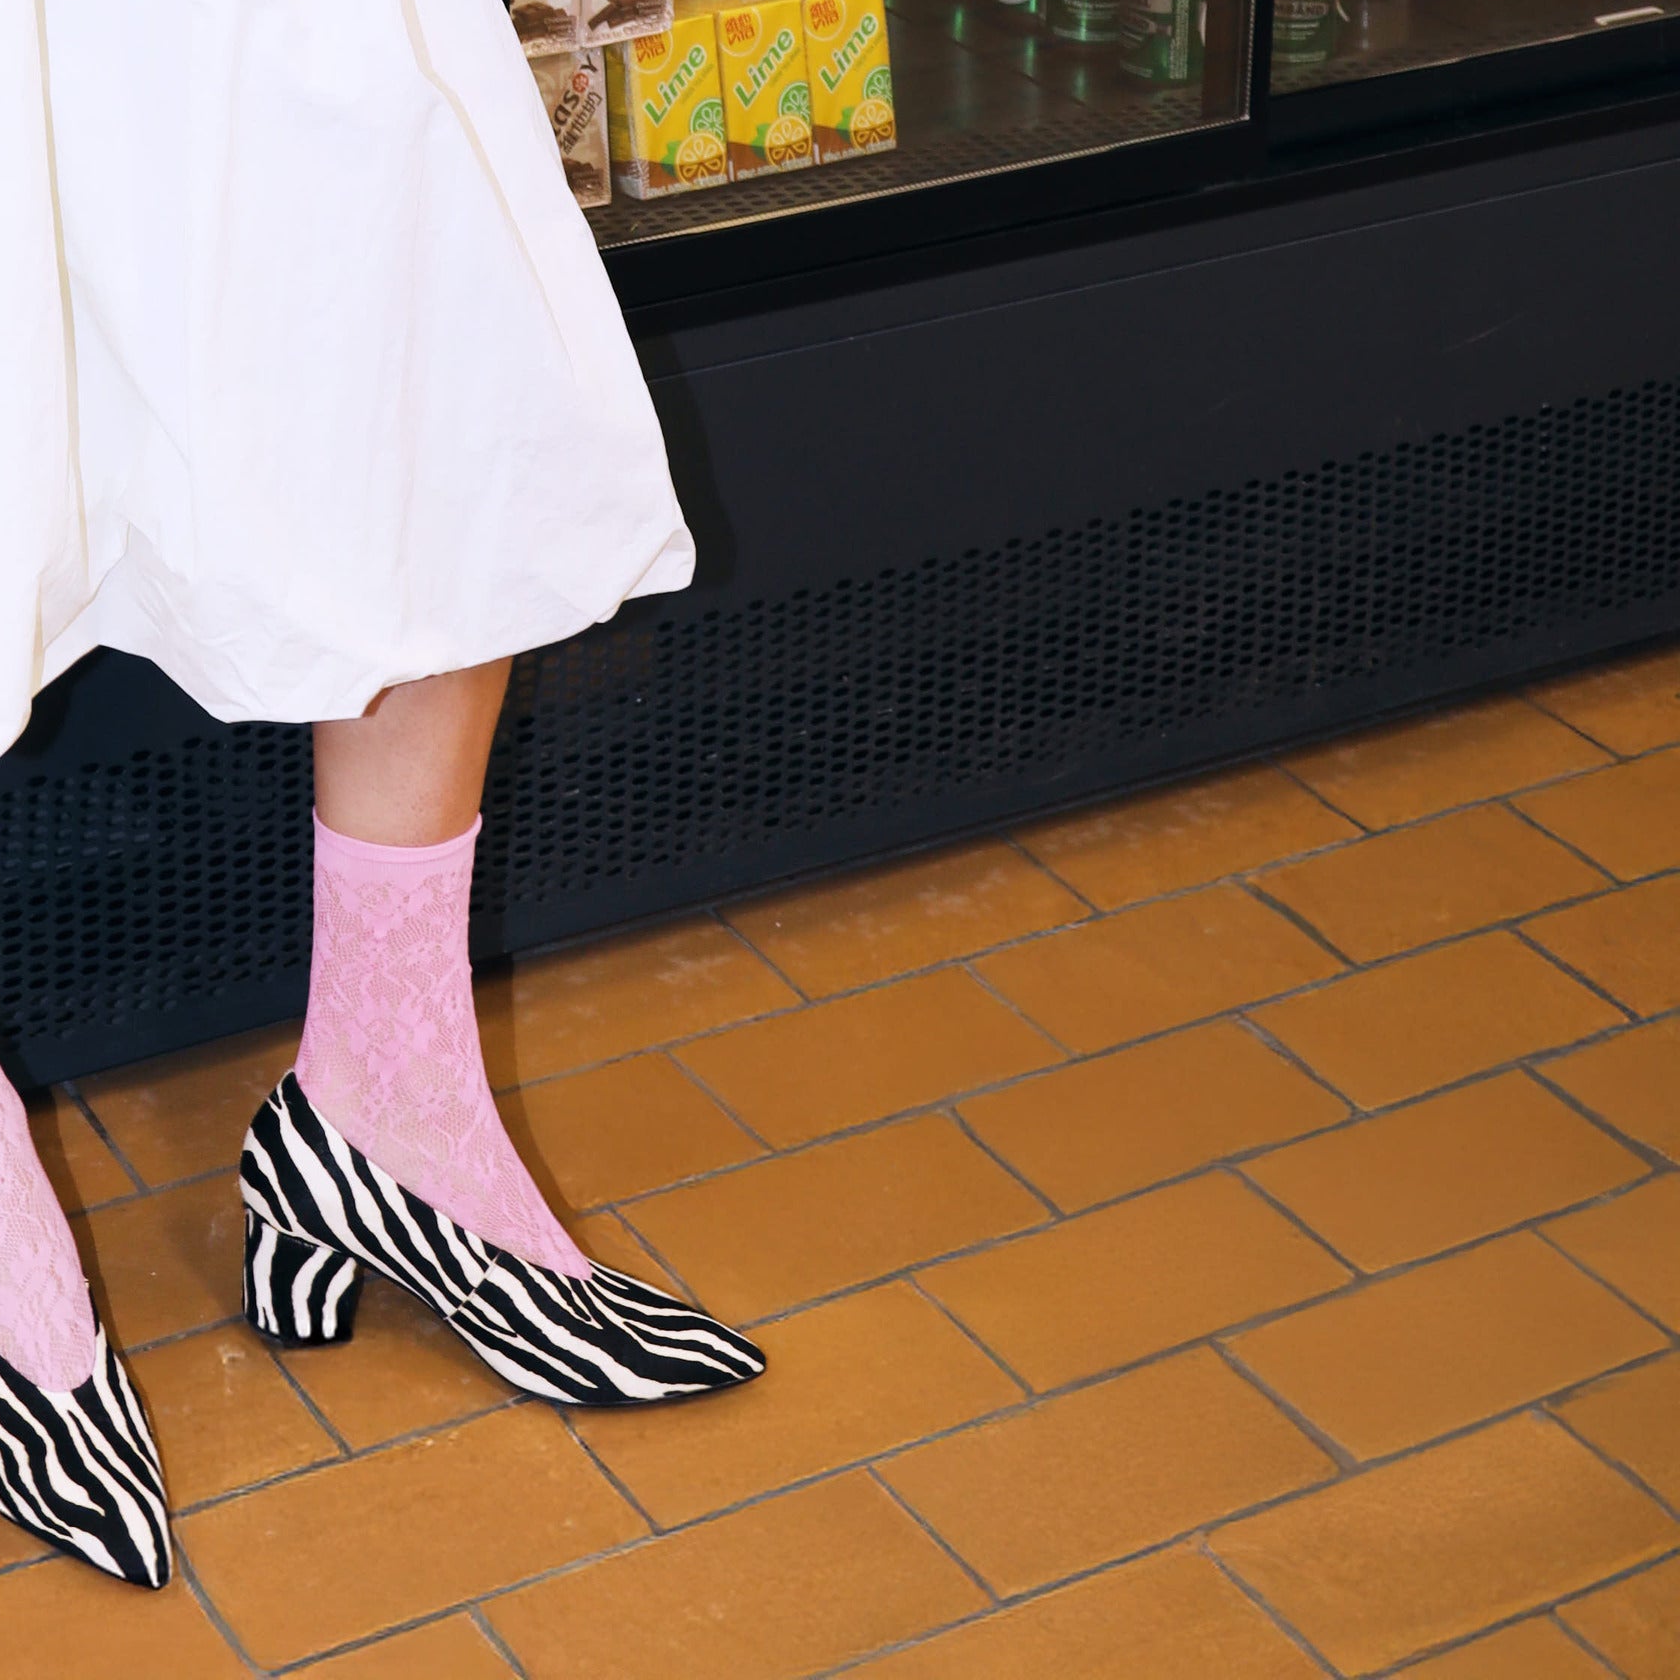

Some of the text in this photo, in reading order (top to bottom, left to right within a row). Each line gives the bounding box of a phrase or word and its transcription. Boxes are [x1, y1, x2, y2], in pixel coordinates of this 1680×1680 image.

[642, 42, 708, 128] Lime
[733, 28, 795, 110] Lime
[819, 11, 879, 93] Lime
